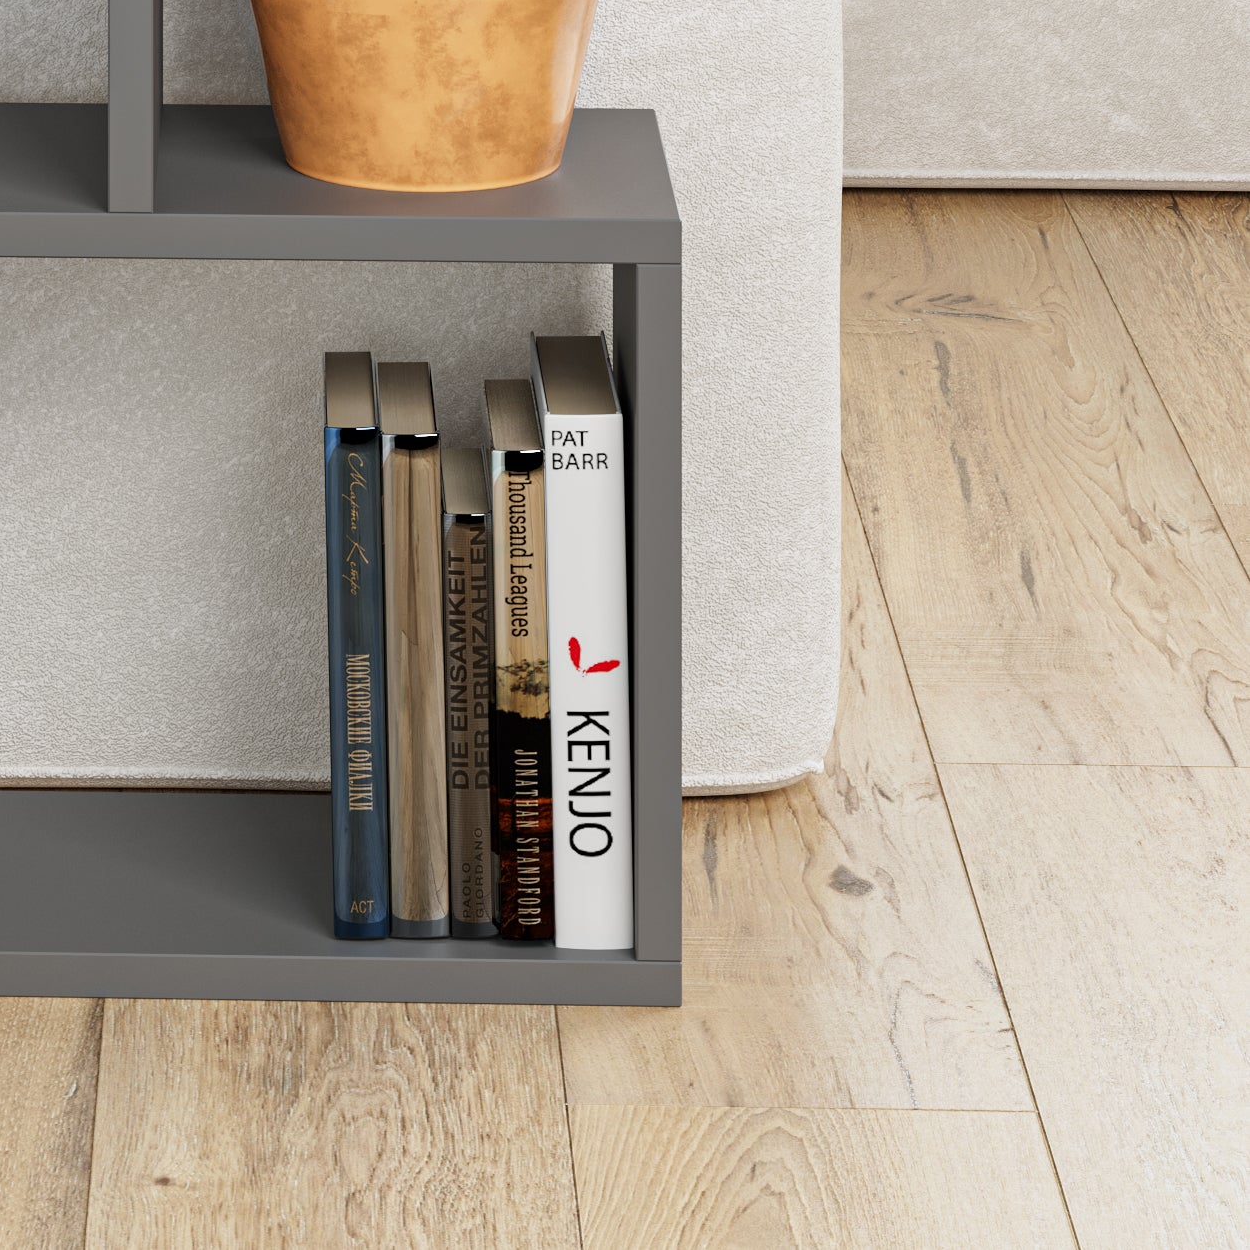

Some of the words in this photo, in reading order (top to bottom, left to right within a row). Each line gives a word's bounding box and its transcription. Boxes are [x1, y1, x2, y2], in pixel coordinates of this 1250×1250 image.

[551, 430, 589, 447] PAT
[552, 453, 608, 470] BARR
[507, 472, 533, 558] Thousand
[470, 526, 489, 720] PRIMZAHLEN
[505, 564, 533, 638] Leagues
[448, 550, 468, 733] EINSAMKEIT
[452, 741, 469, 790] DIE
[474, 729, 490, 790] DER
[514, 749, 539, 829] JONATHAN
[565, 711, 614, 857] KENJO
[462, 862, 471, 918] PAOLO
[474, 828, 484, 918] GIORDANO
[516, 837, 542, 926] STANDFORD
